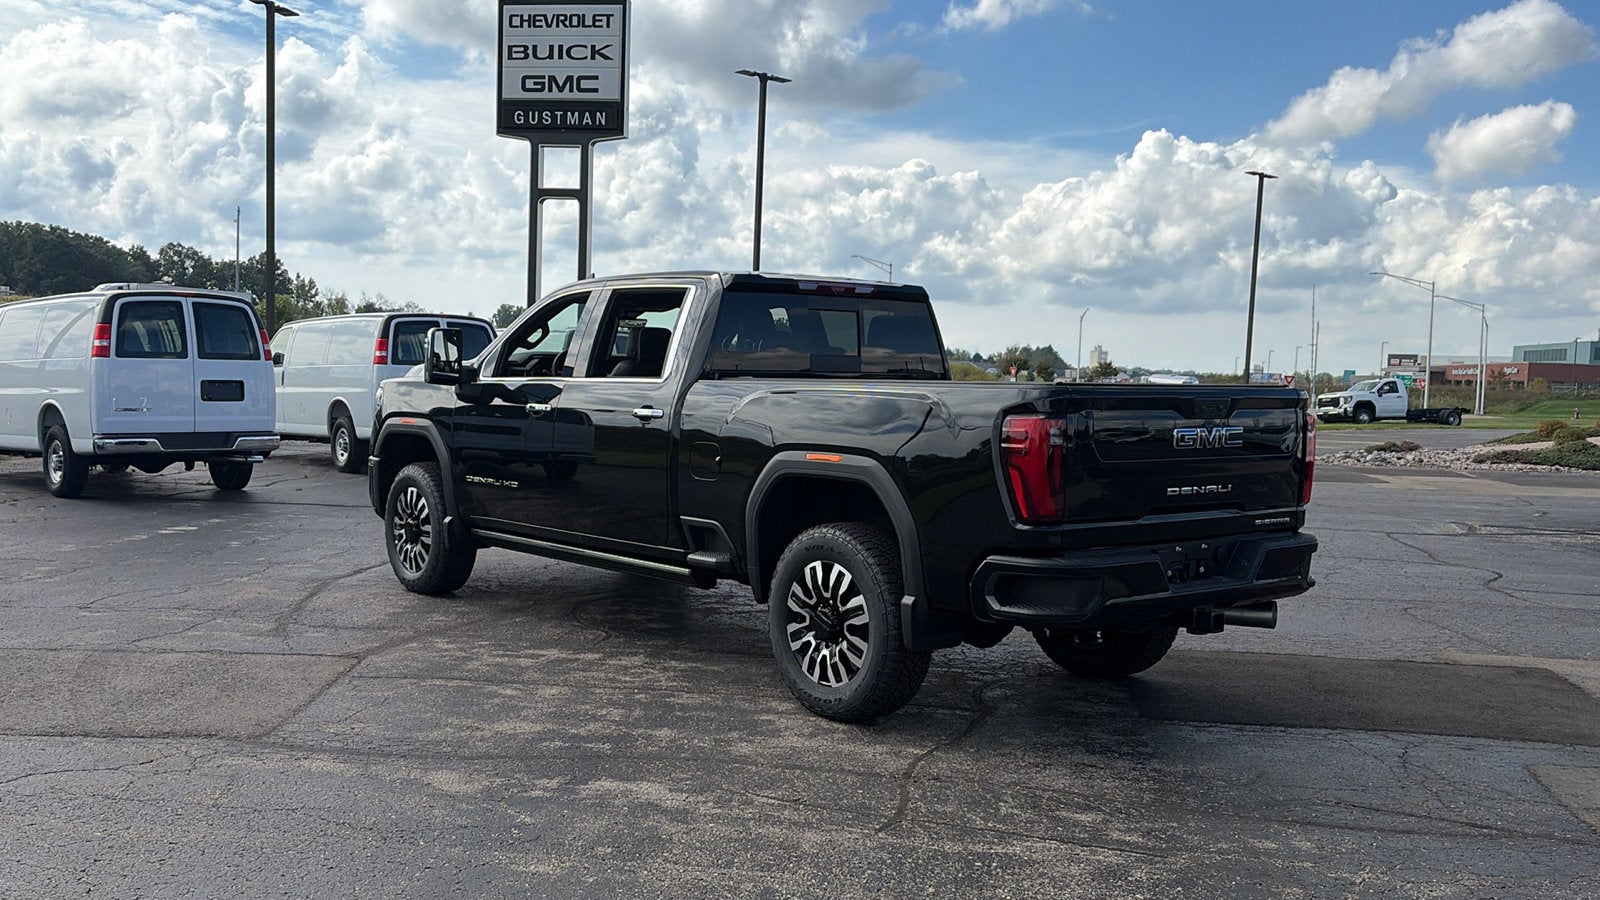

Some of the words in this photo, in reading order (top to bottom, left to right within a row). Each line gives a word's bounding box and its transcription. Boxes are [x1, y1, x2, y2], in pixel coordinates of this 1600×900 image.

[509, 13, 614, 29] CHEVROLET
[507, 44, 614, 61] BUICK
[521, 75, 599, 93] GMC
[514, 110, 606, 125] GUSTMAN
[1173, 427, 1243, 450] GMC
[465, 475, 502, 486] DENALI
[1166, 483, 1232, 496] DENALI
[1254, 517, 1291, 526] SIERRA
